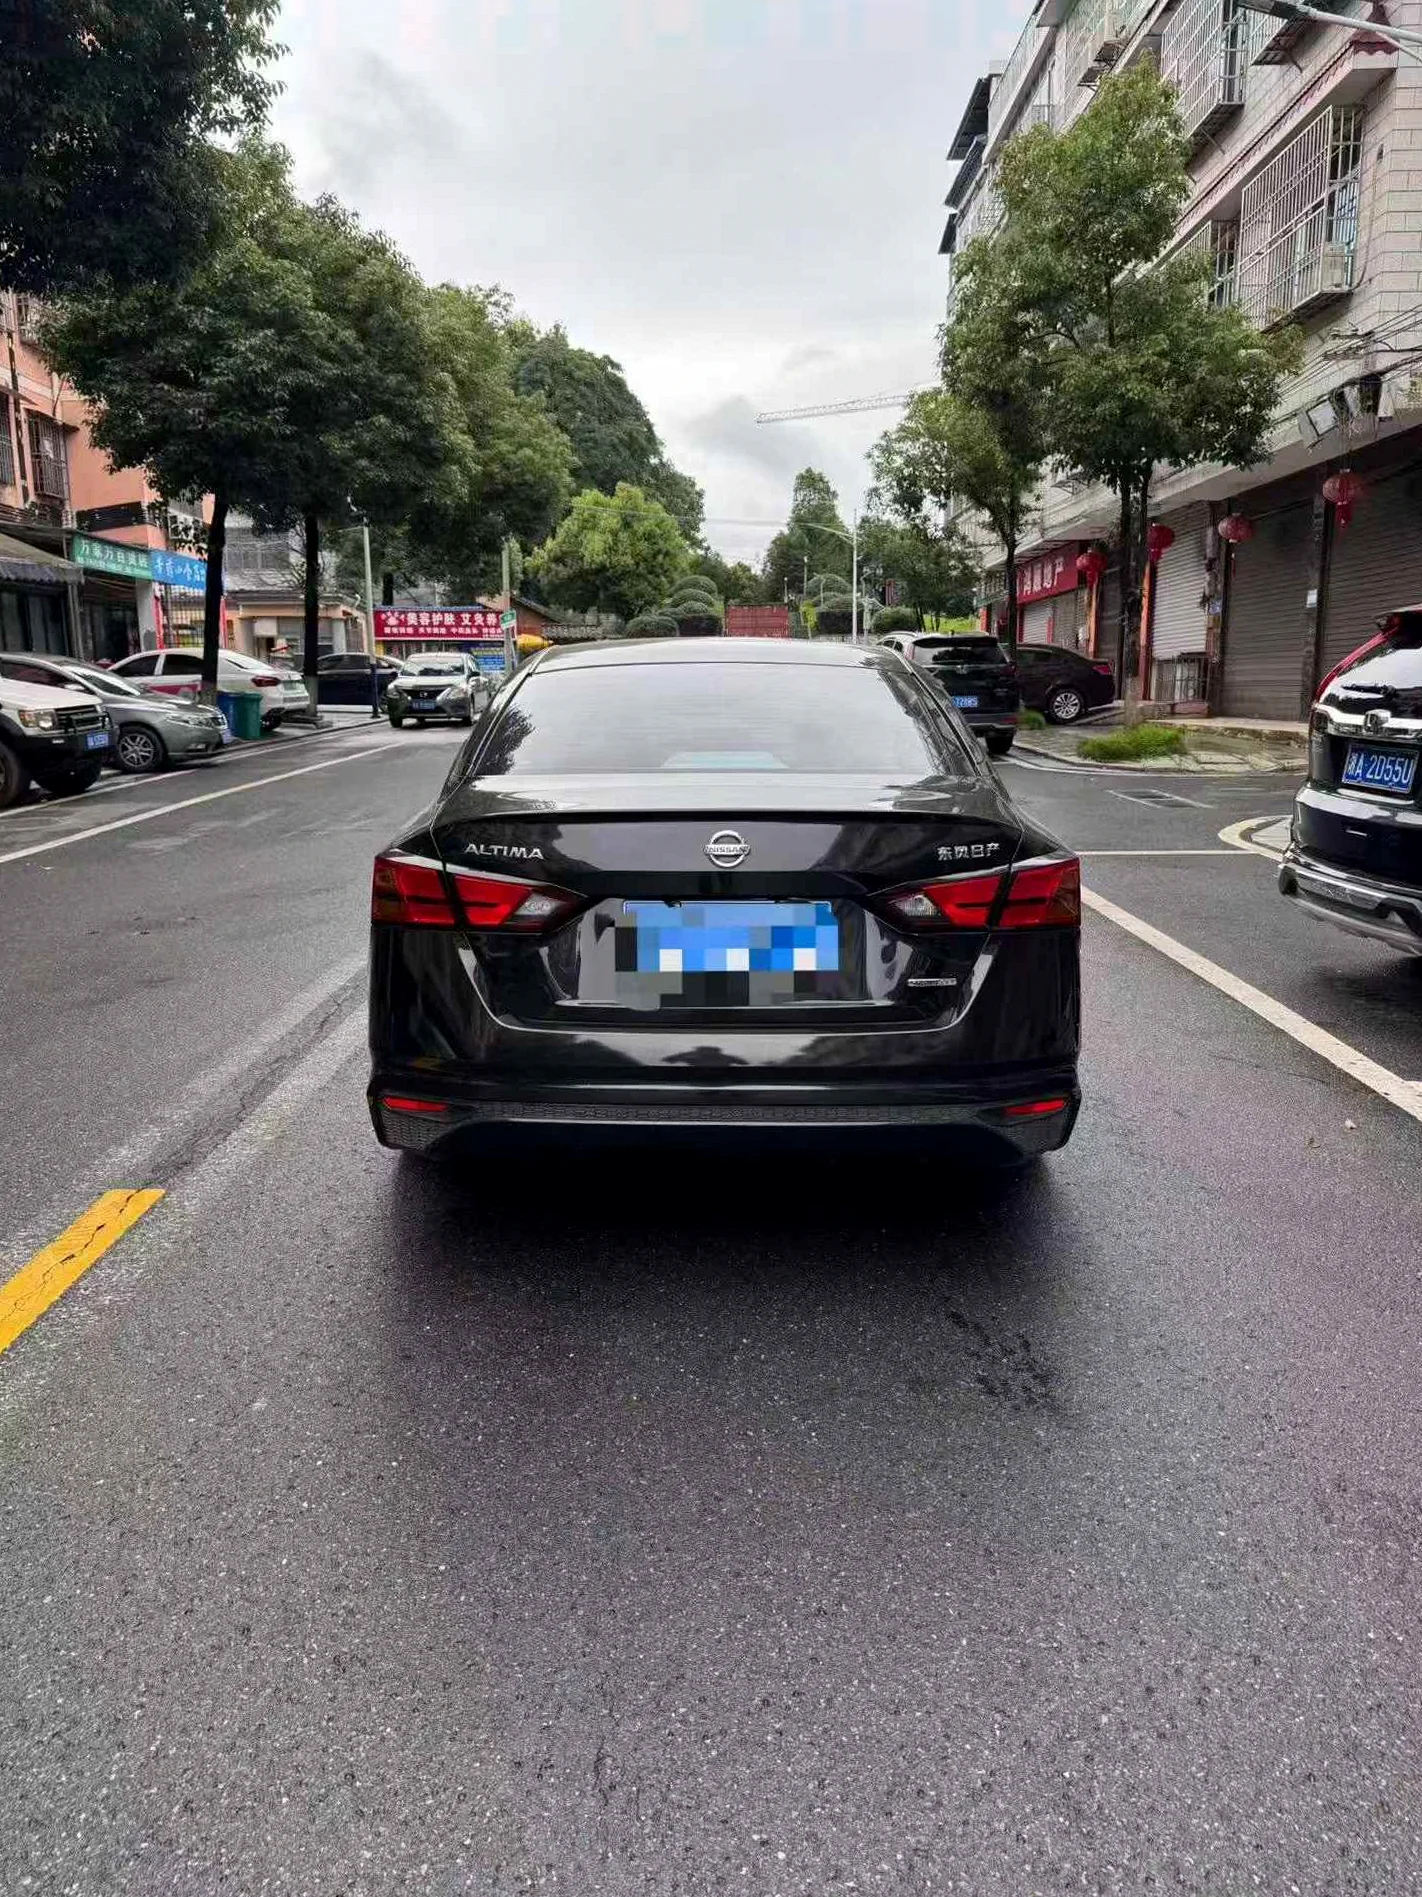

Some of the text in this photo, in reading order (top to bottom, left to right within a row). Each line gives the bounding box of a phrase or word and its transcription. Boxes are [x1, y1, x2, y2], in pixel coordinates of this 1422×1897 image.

[407, 612, 456, 626] 美容护肤
[461, 612, 500, 626] 艾灸养
[463, 842, 545, 861] ALTIMA
[706, 844, 749, 855] NISSAN
[936, 842, 1000, 861] 东风日产
